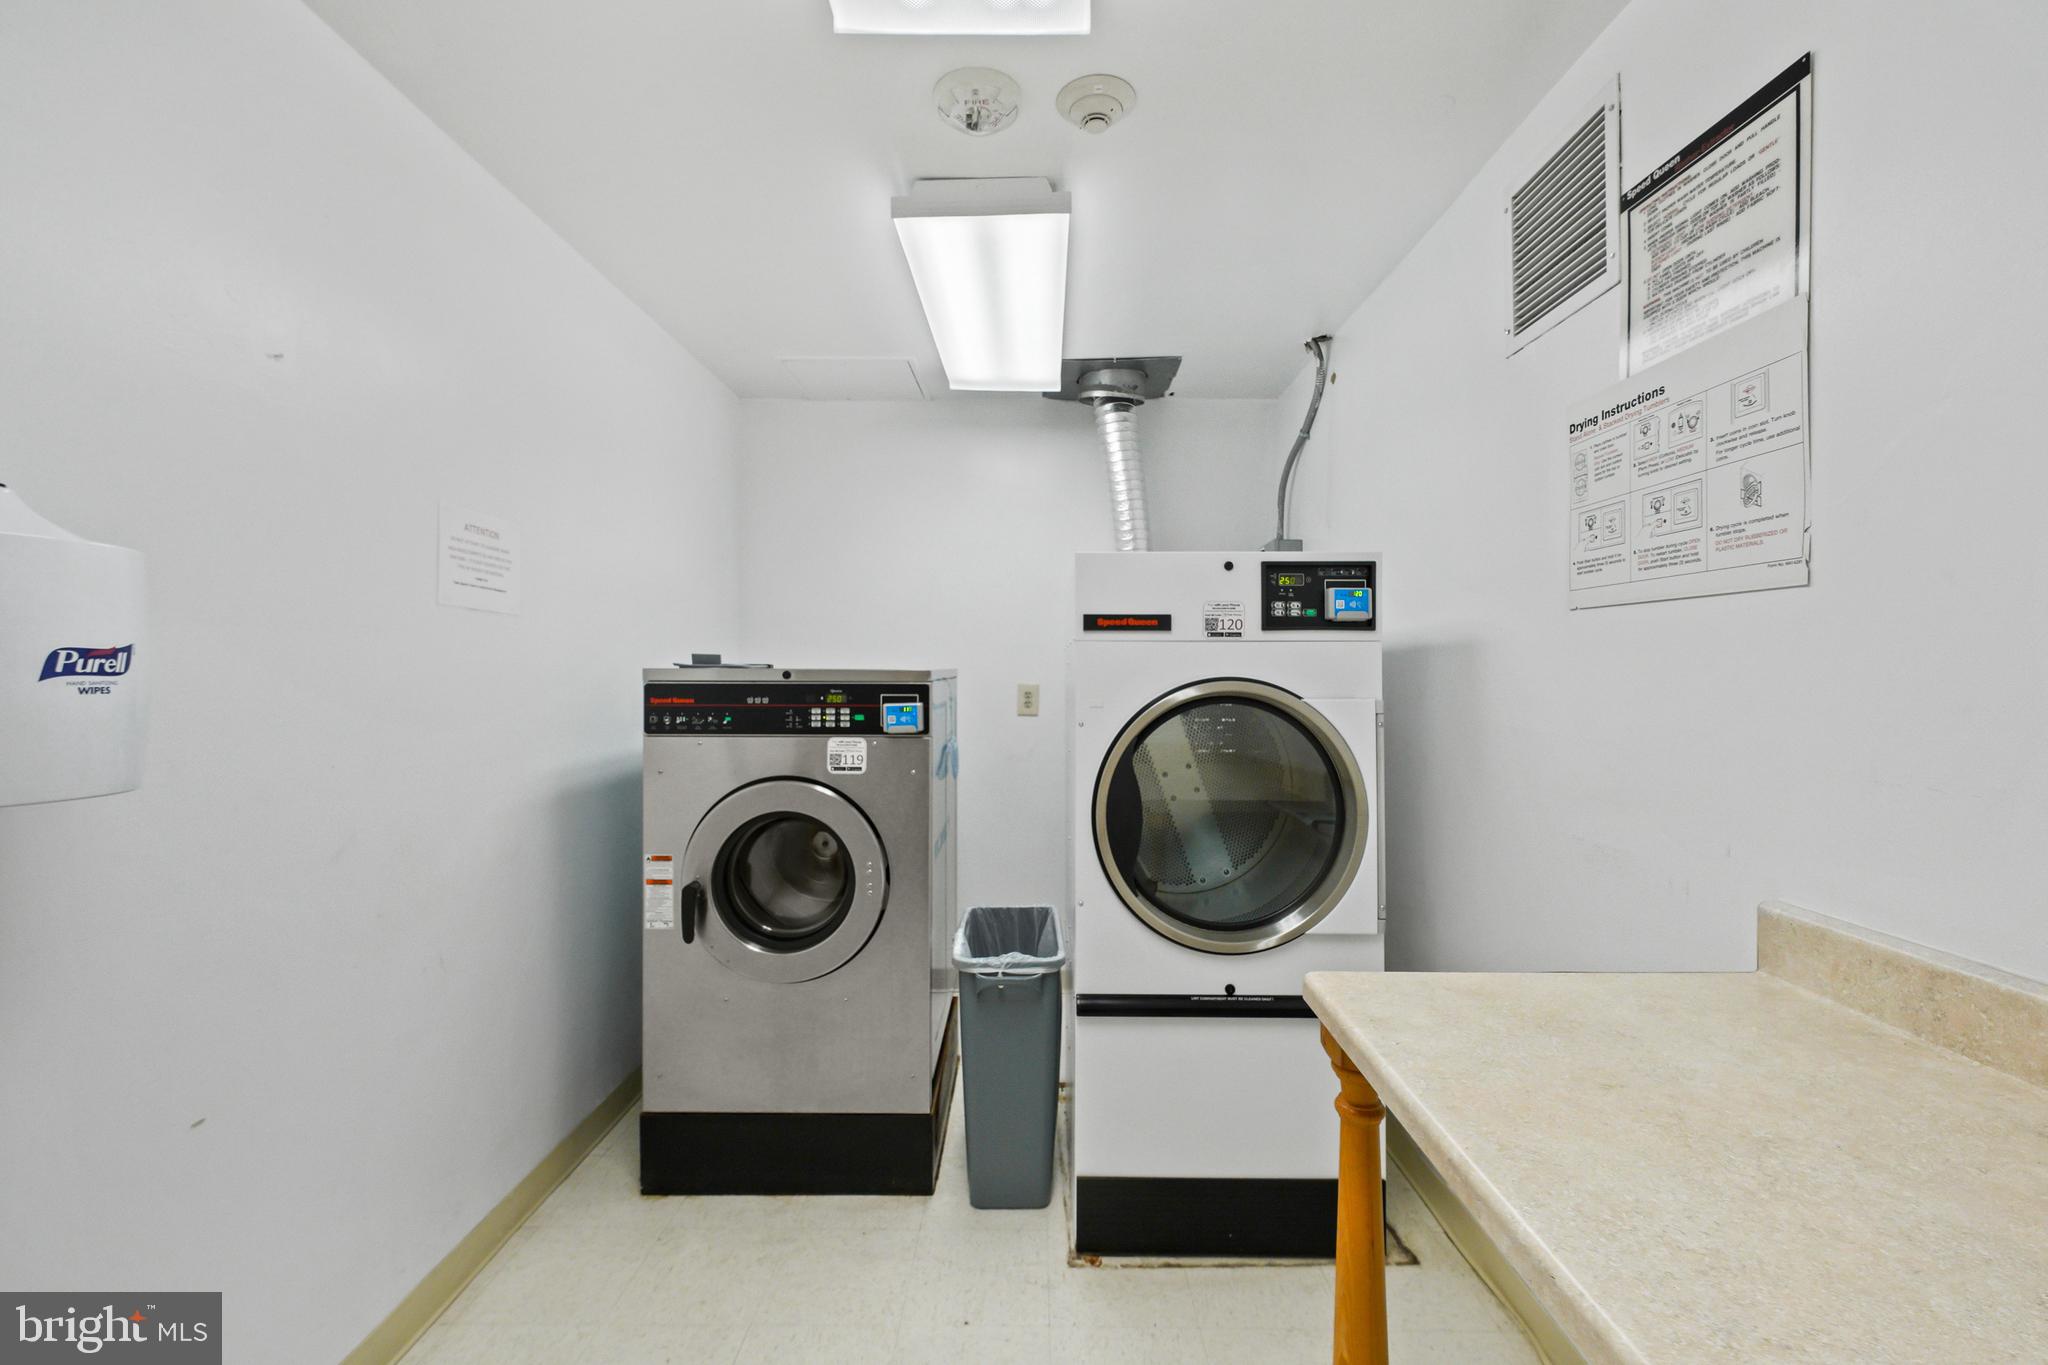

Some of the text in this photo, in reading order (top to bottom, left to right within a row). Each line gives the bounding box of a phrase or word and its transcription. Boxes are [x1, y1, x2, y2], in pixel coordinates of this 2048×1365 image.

[1626, 175, 1650, 200] Speed
[1653, 155, 1680, 180] Queen
[1570, 384, 1666, 434] Drying Instructions
[1220, 618, 1242, 630] 120
[55, 650, 128, 672] Purell
[78, 686, 111, 695] WIPES
[842, 754, 864, 765] 119
